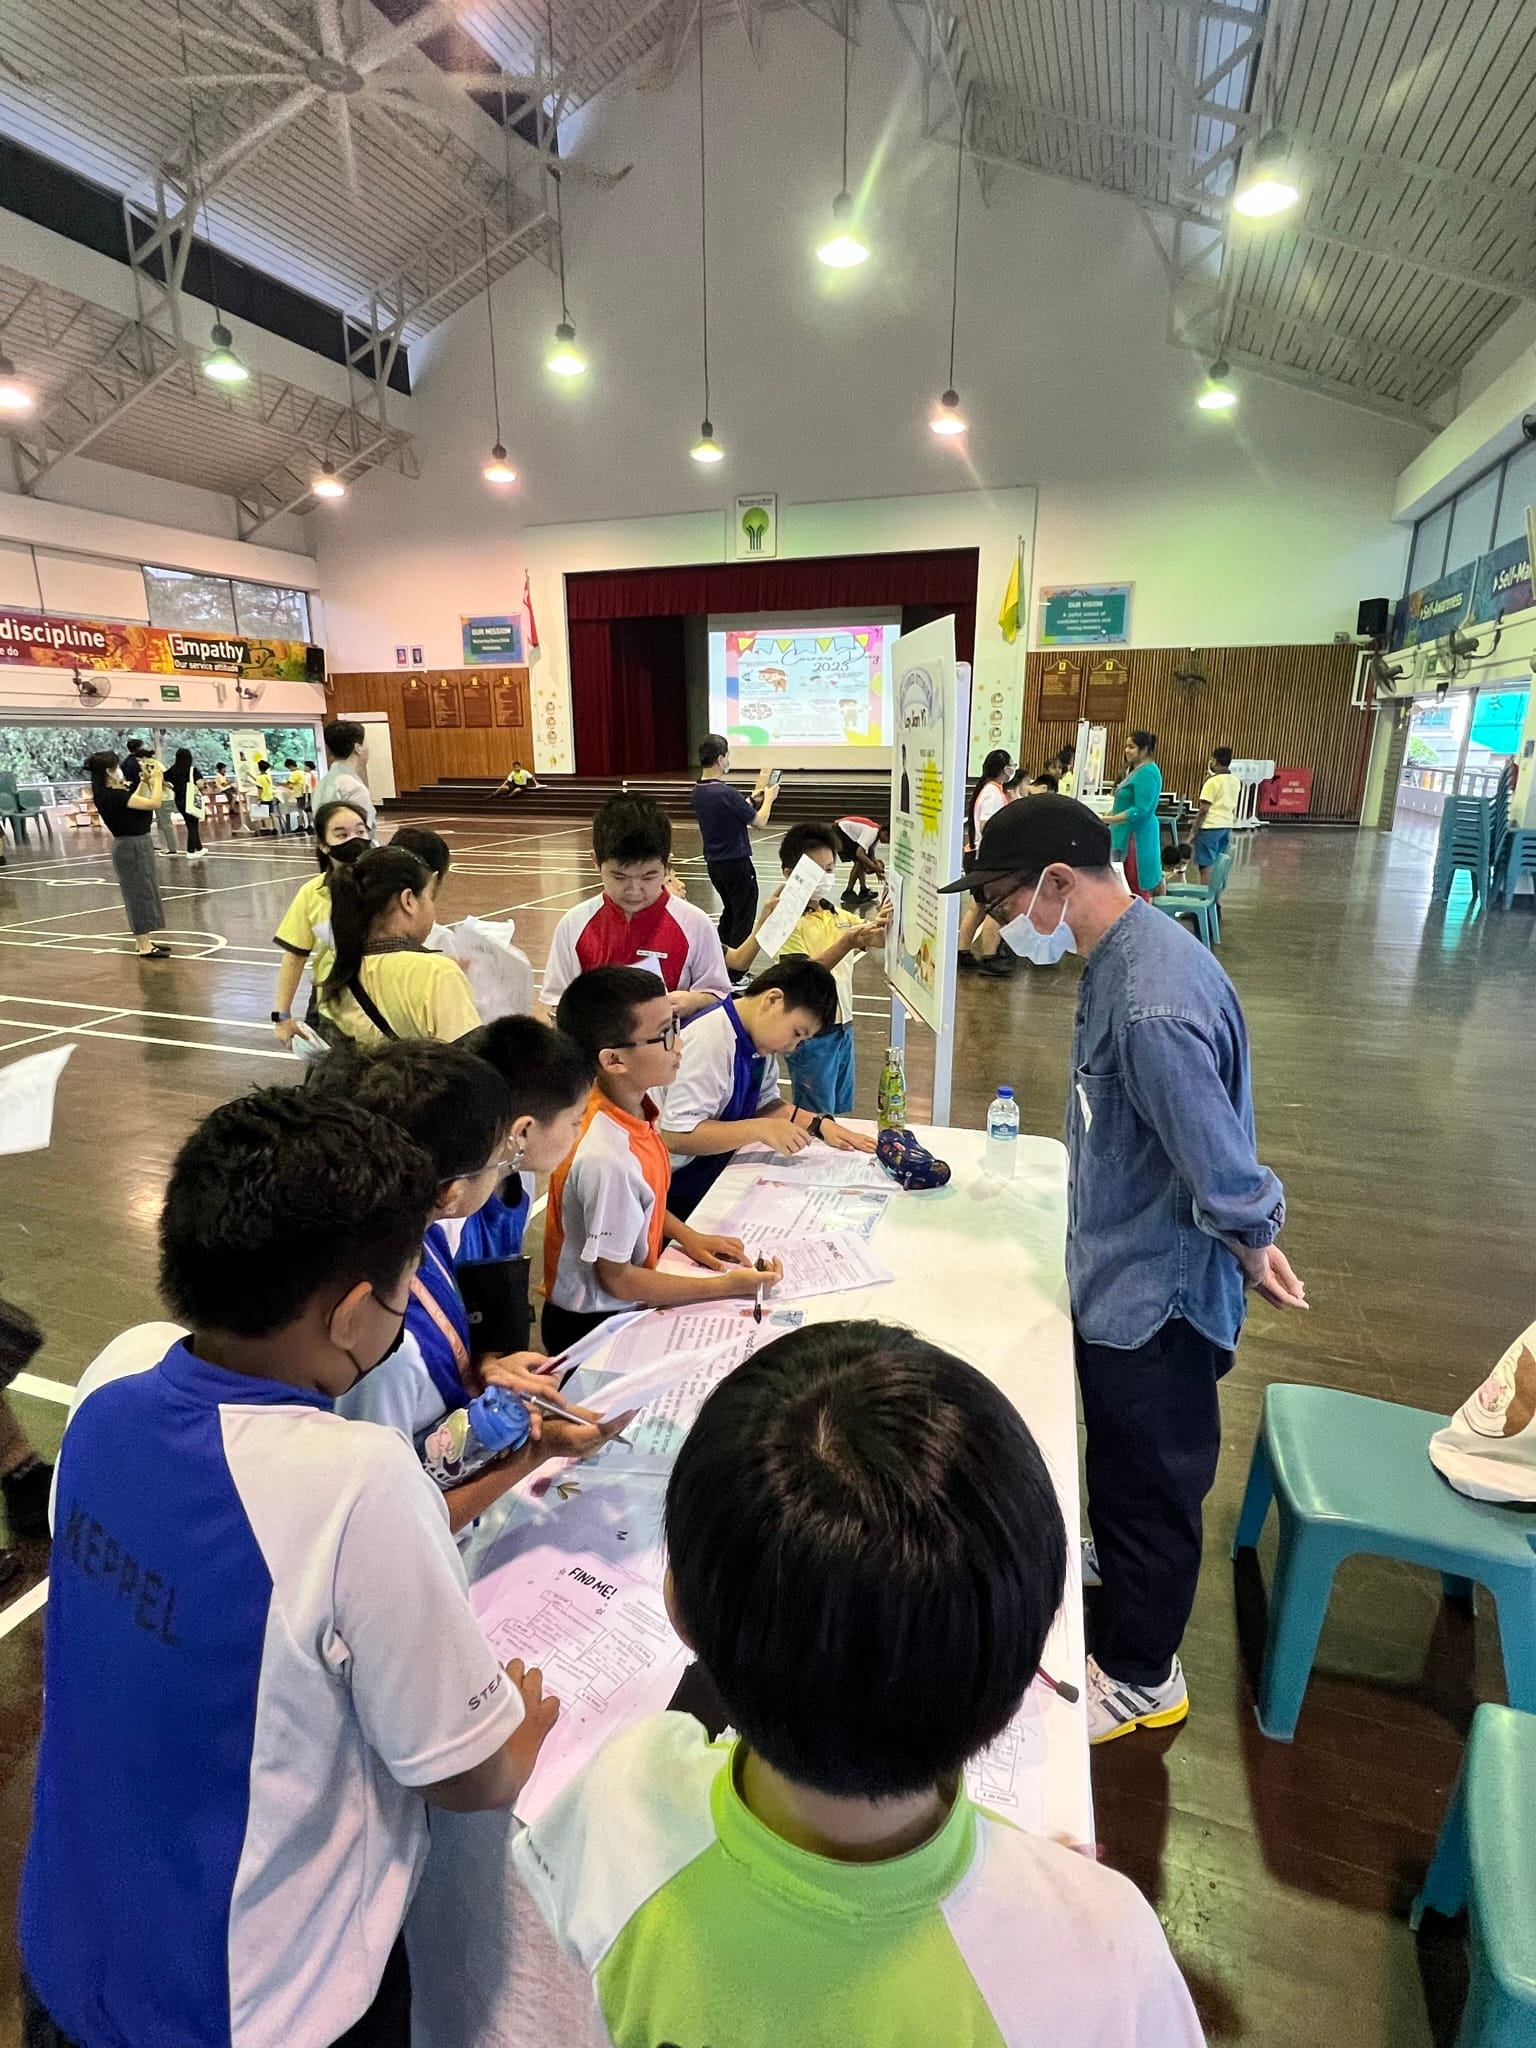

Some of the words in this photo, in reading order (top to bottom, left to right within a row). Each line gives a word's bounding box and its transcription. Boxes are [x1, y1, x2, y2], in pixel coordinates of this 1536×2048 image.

[0, 618, 105, 649] discipline
[7, 646, 19, 656] do
[168, 633, 244, 663] Empathy
[174, 659, 188, 668] Our
[189, 661, 213, 671] service
[812, 661, 849, 672] 2023
[568, 1567, 596, 1586] FIND
[593, 1580, 619, 1600] ME!
